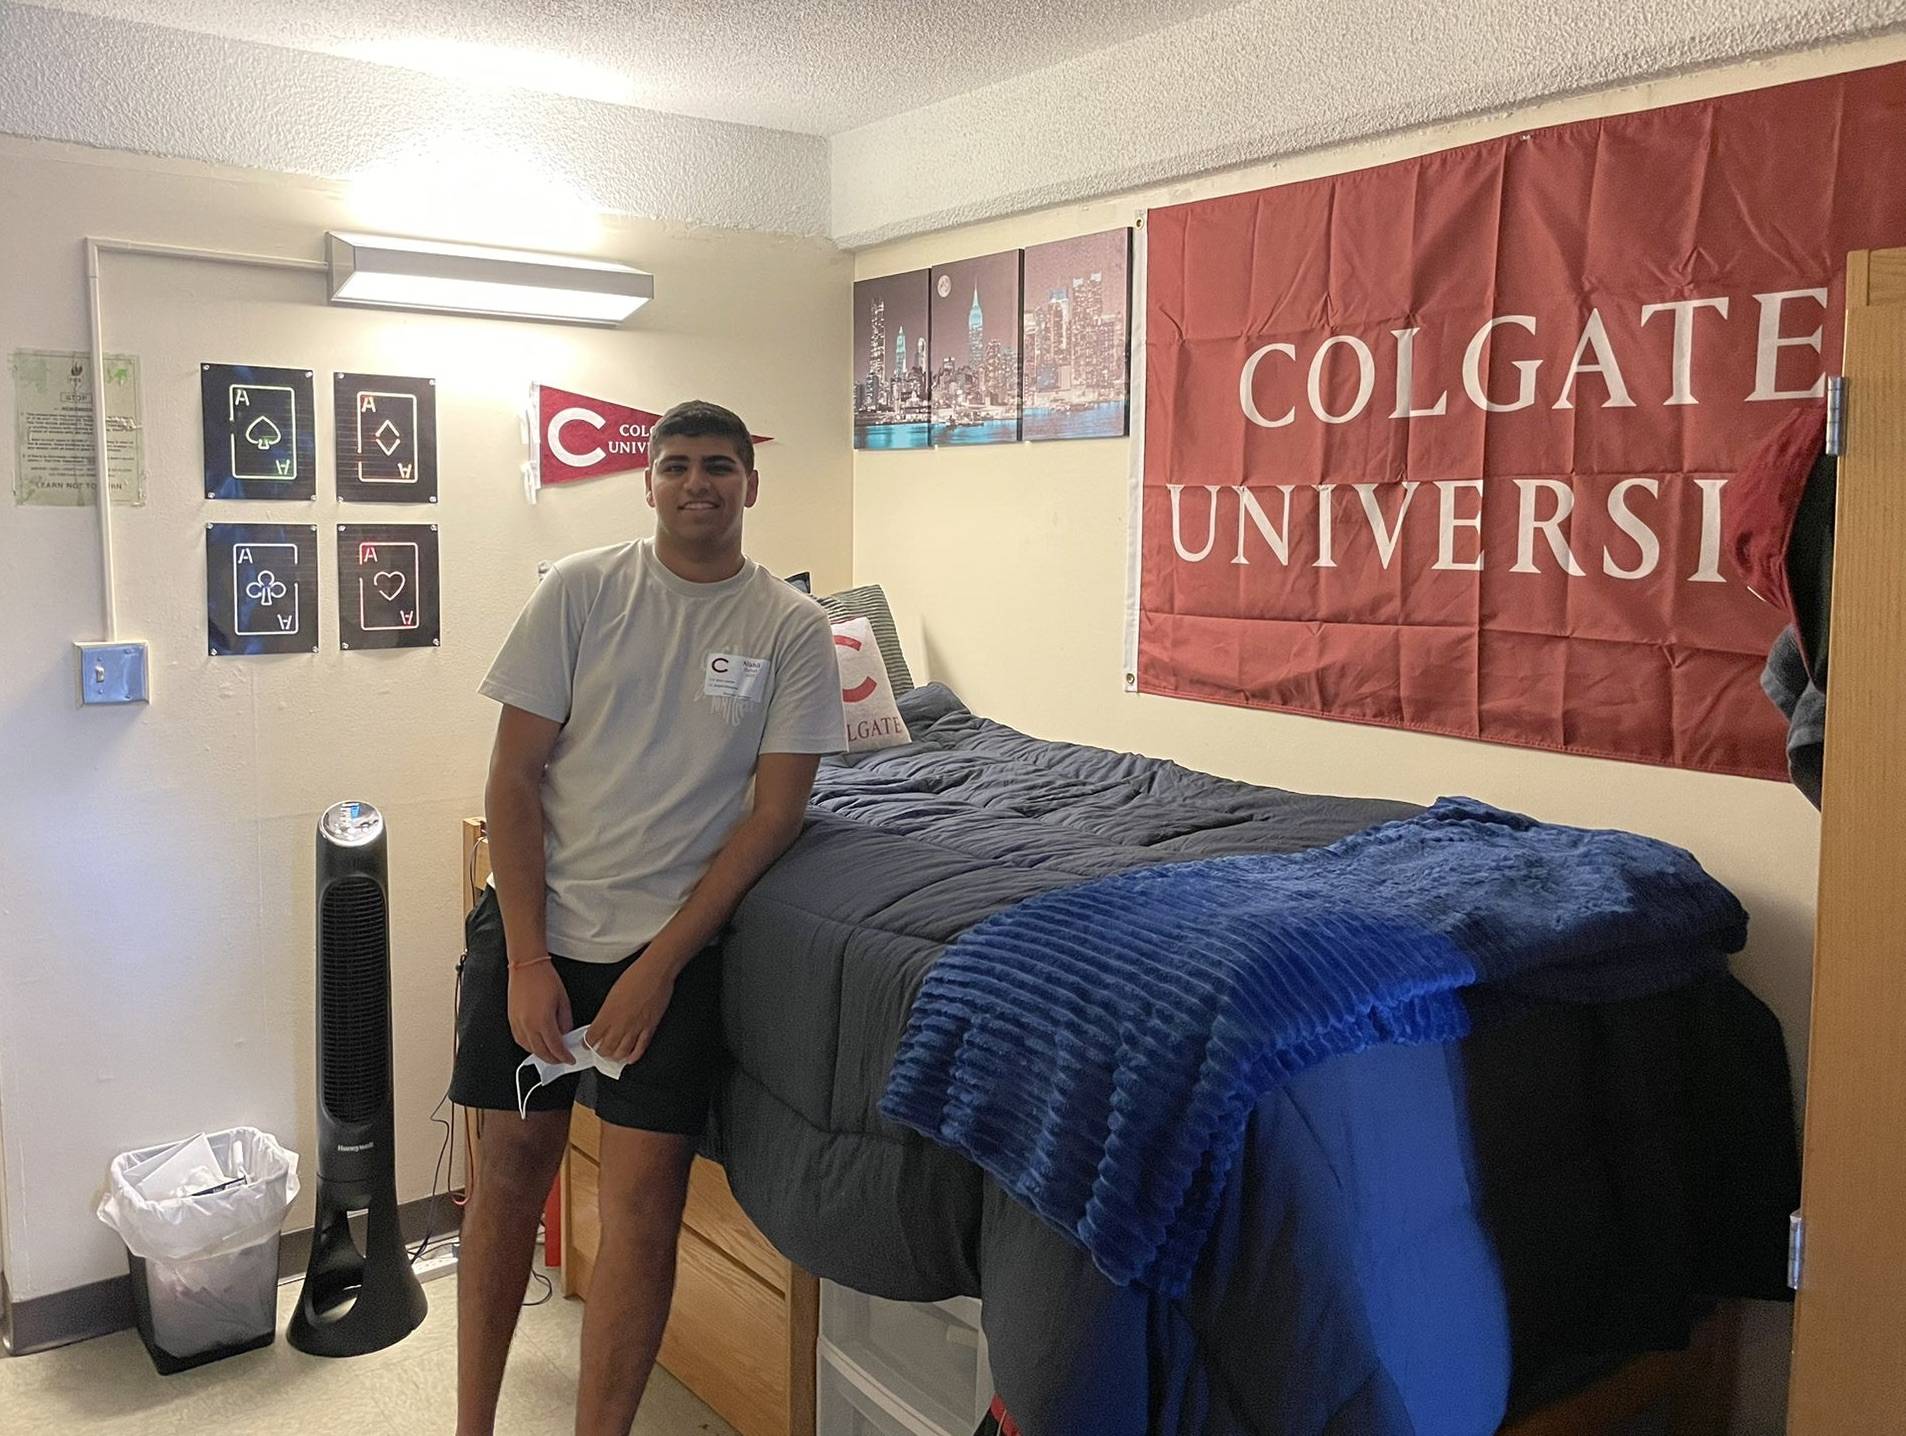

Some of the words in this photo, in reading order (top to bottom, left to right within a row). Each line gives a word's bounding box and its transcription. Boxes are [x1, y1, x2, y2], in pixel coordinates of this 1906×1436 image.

[1238, 287, 1829, 428] COLGATE
[234, 389, 250, 406] A
[361, 397, 376, 413] A
[547, 407, 607, 467] C
[276, 459, 290, 475] A
[397, 462, 412, 479] A
[35, 481, 64, 489] LEARN
[1165, 477, 1730, 584] UNIVERSI
[238, 548, 253, 564] A
[363, 547, 378, 562] A
[277, 614, 292, 630] A
[399, 610, 414, 625] A
[711, 657, 729, 673] C
[847, 716, 903, 742] LGATE
